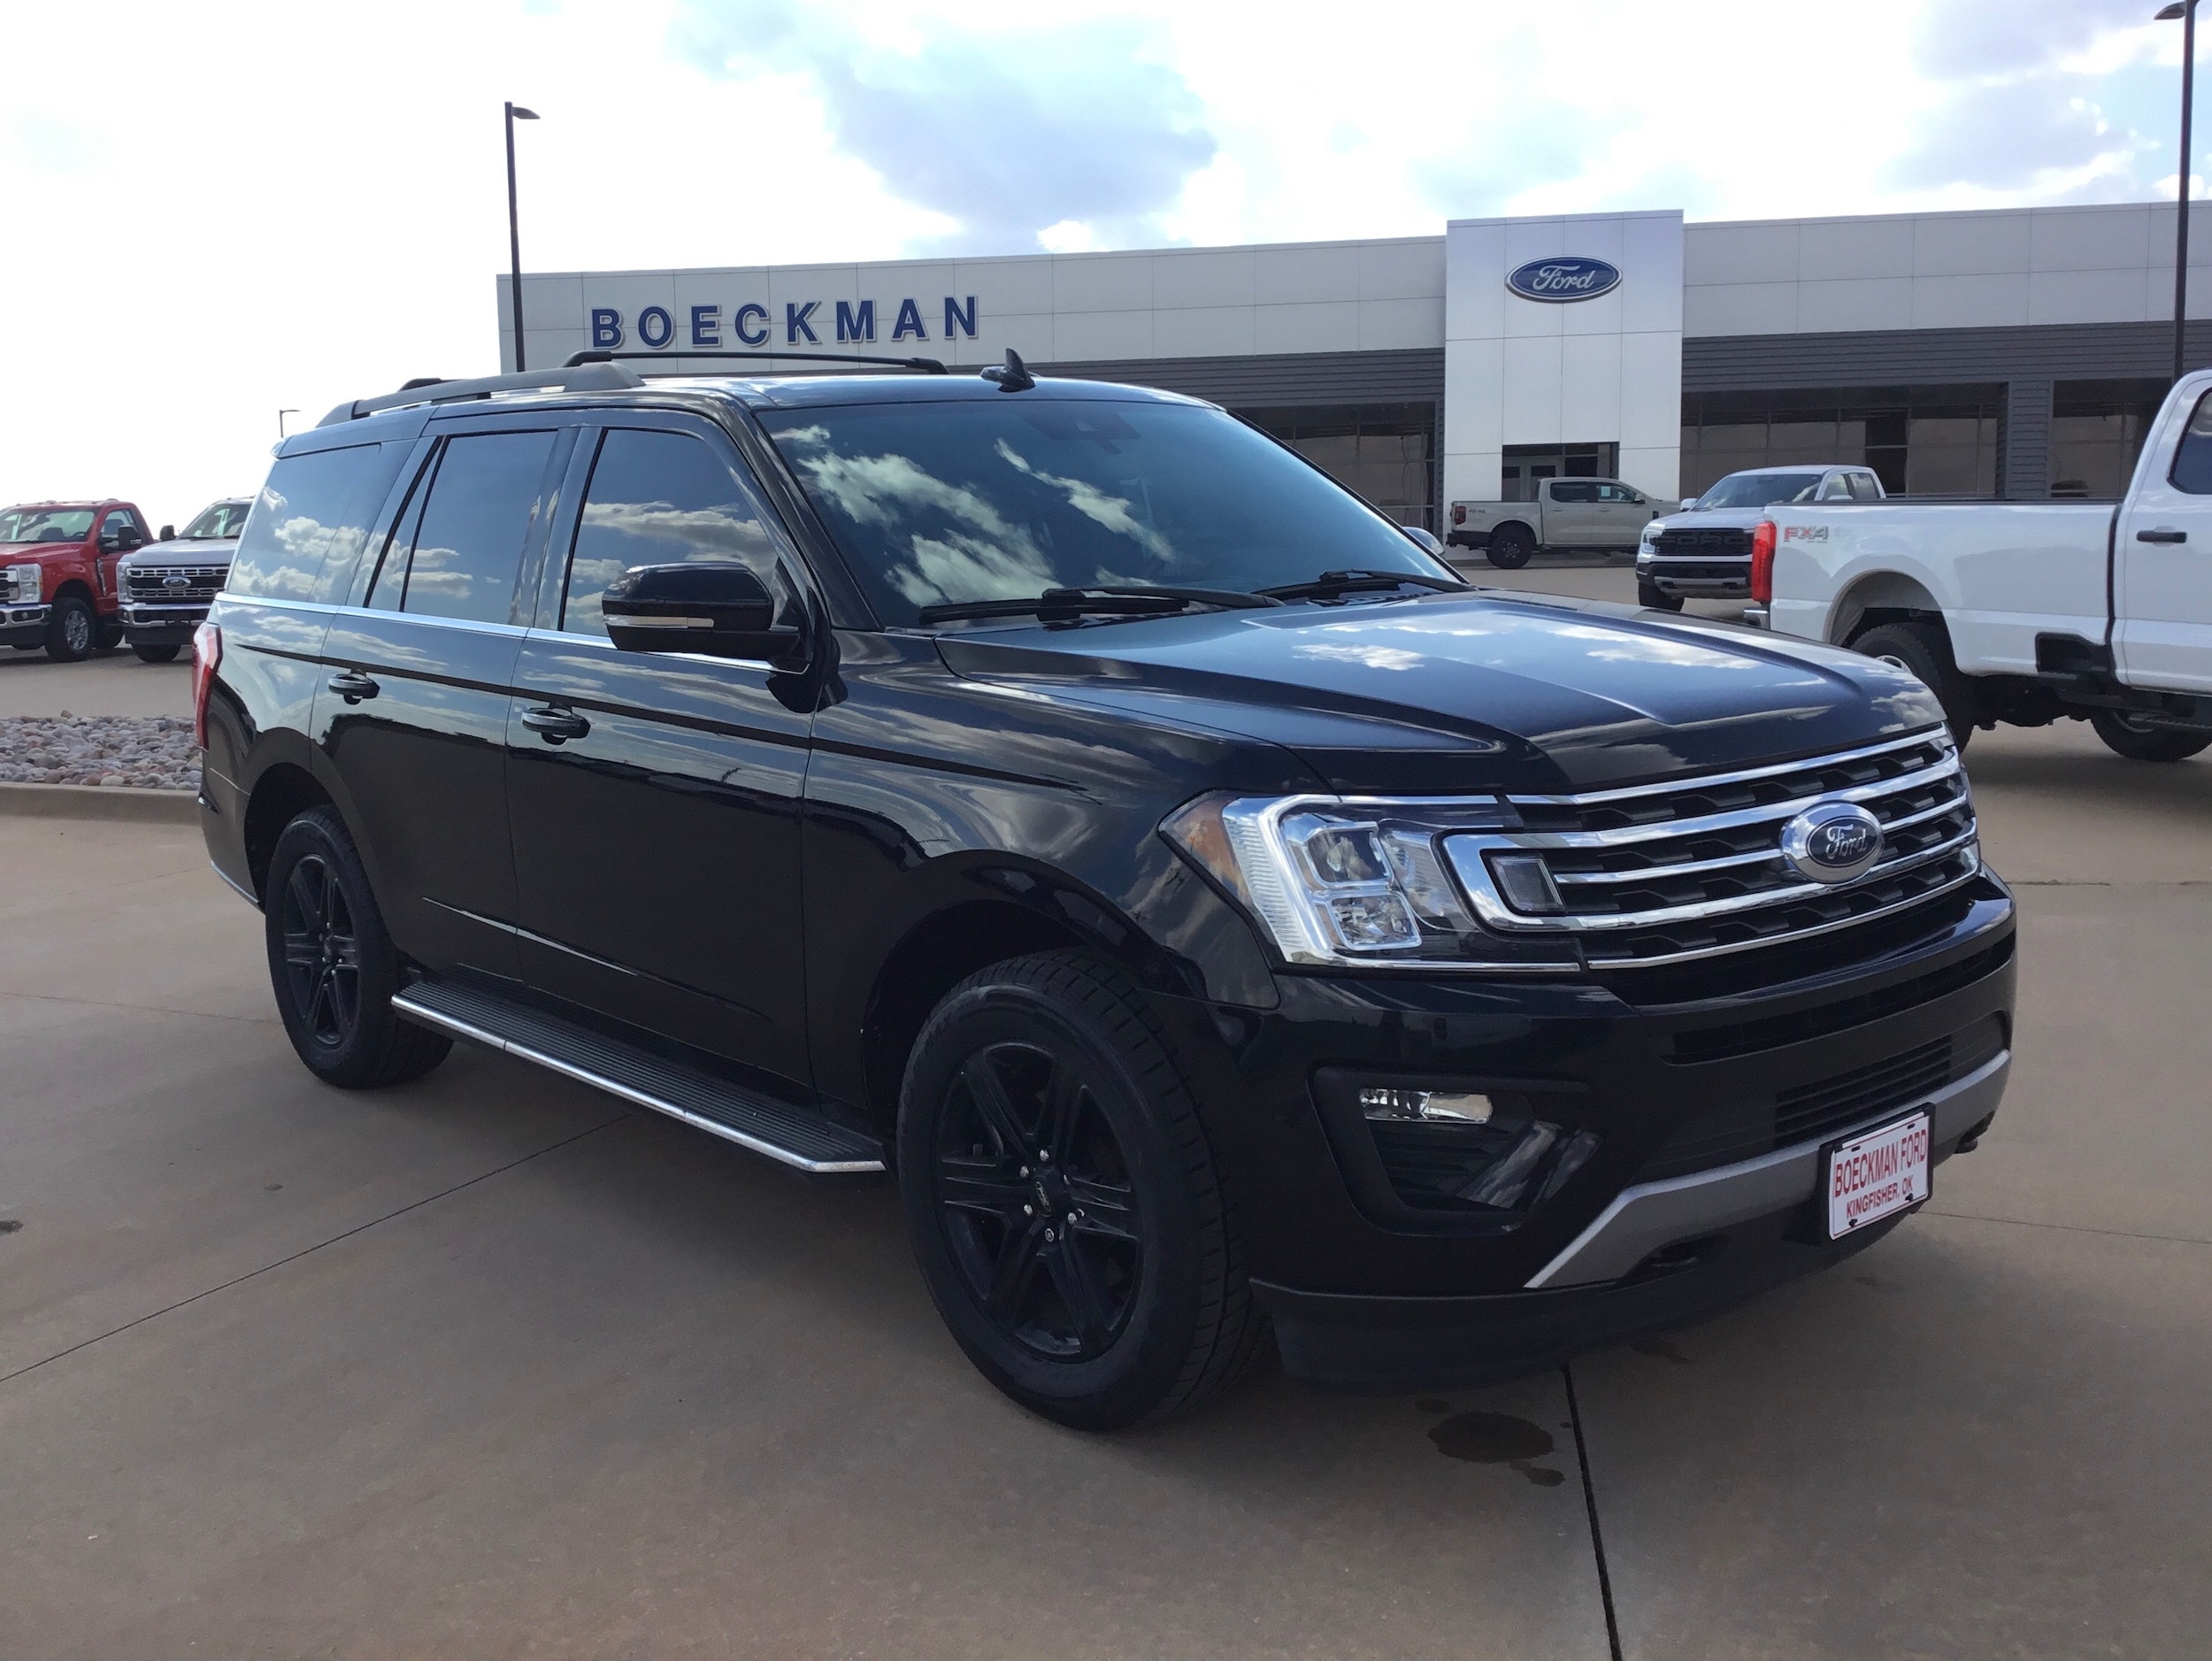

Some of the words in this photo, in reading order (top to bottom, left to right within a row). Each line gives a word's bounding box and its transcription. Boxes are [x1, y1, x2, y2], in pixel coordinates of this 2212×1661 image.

[1532, 265, 1596, 290] Ford
[590, 295, 979, 350] BOECKMAN
[1784, 526, 1829, 542] FX4
[1825, 824, 1868, 859] Ford
[1834, 1141, 1899, 1197] BOECKMAN
[1901, 1129, 1926, 1171] FORD
[1903, 1174, 1914, 1195] OK
